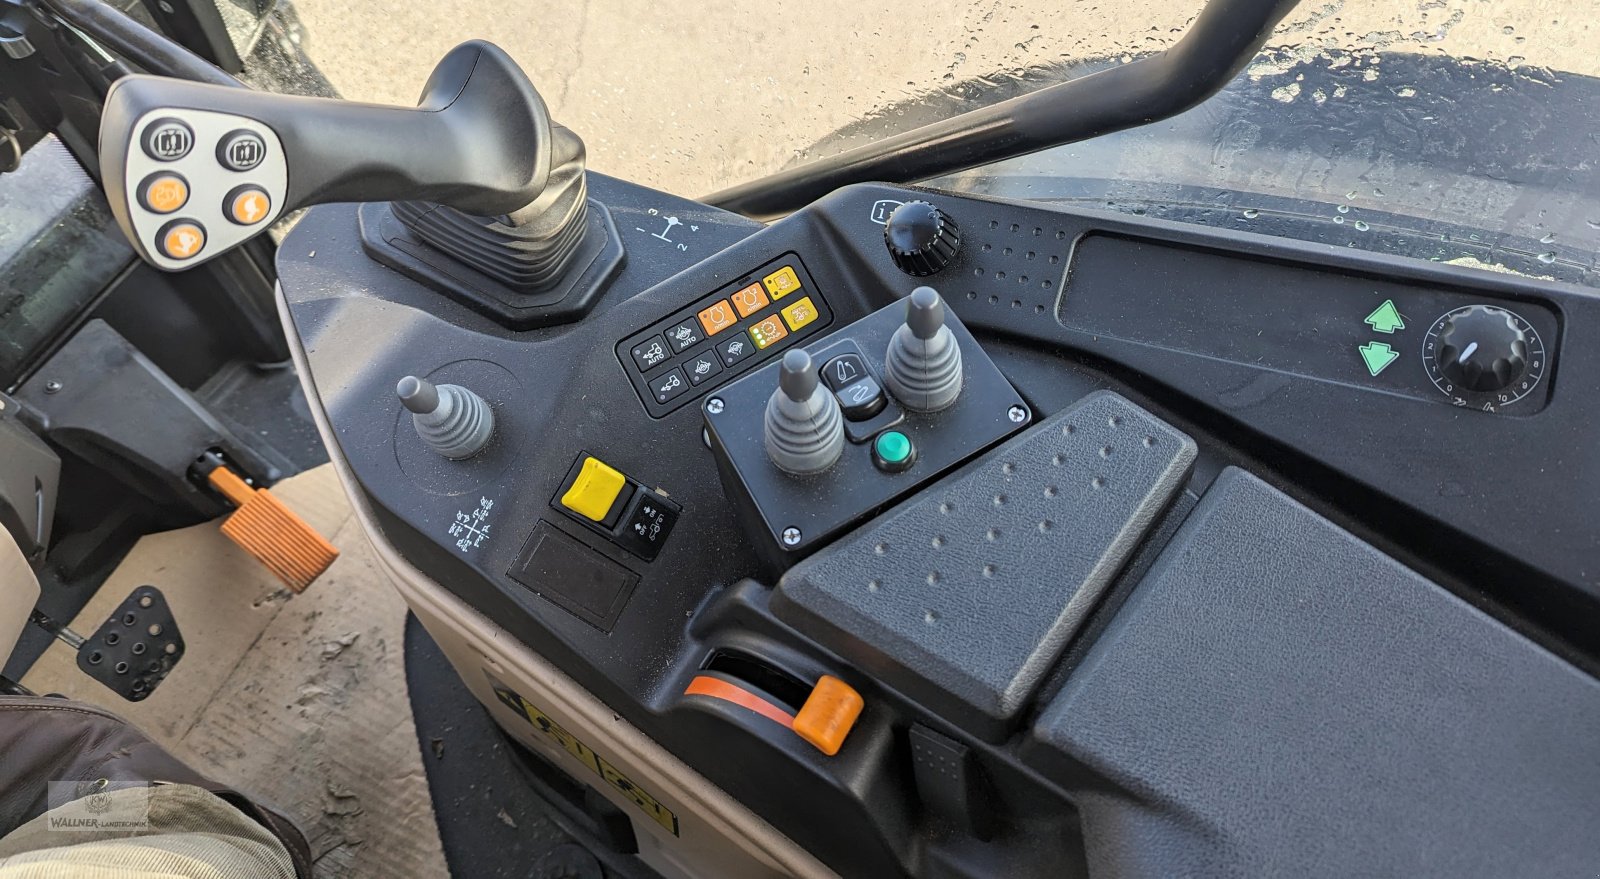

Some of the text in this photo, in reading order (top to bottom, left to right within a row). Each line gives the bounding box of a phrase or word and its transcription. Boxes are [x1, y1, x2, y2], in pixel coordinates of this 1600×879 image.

[648, 208, 658, 216] 3
[677, 243, 688, 251] 2
[1439, 322, 1445, 330] 3
[680, 336, 697, 348] AUTO
[1530, 336, 1536, 344] 7
[1428, 342, 1434, 350] 2
[648, 353, 664, 365] AUTO
[1533, 360, 1539, 368] 8
[1446, 384, 1453, 392] 0
[1522, 381, 1528, 389] 9
[1498, 394, 1508, 402] 10
